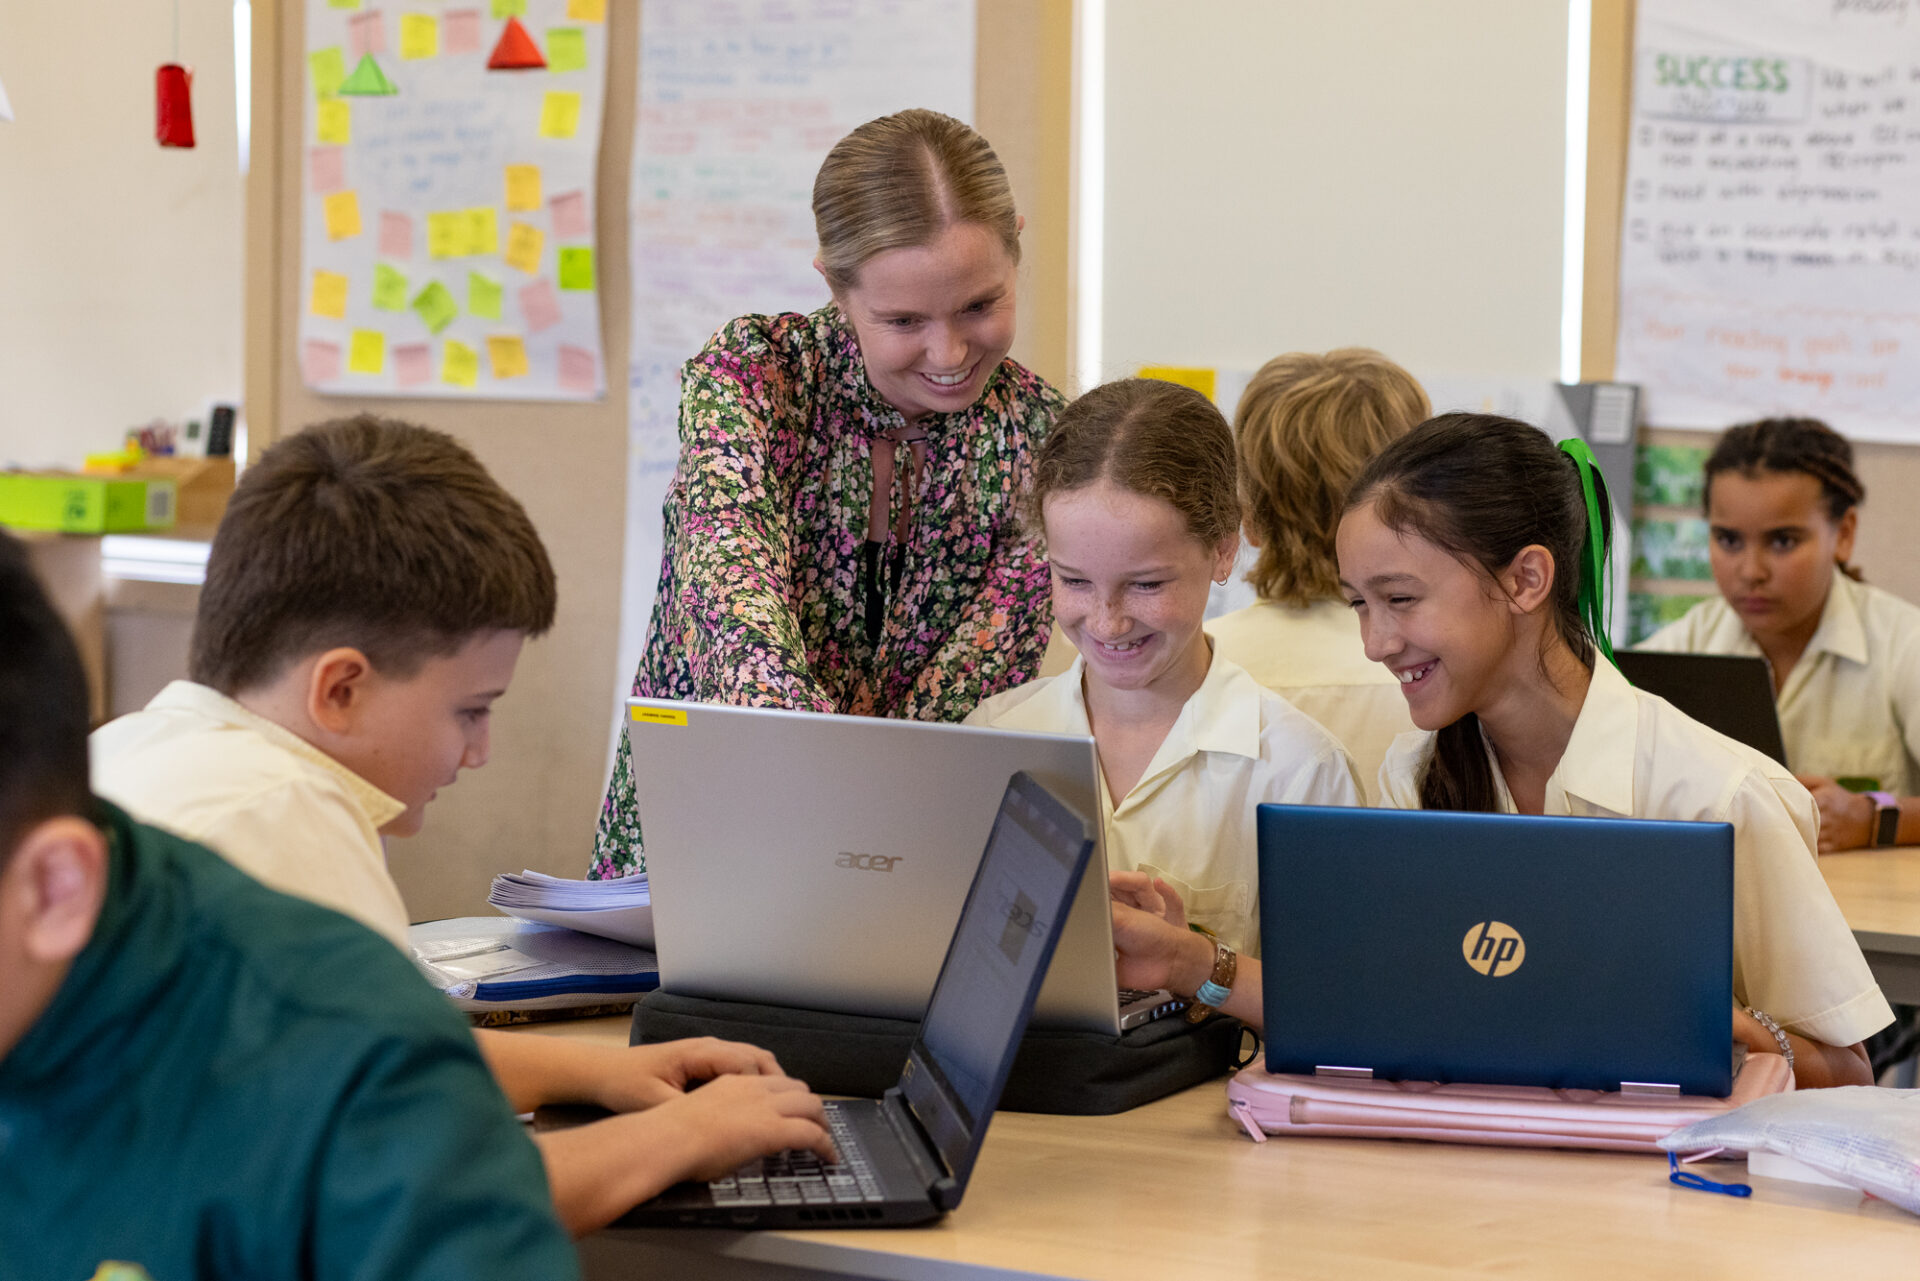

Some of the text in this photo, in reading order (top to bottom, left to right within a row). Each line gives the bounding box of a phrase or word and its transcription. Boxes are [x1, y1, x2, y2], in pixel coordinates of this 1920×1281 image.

[1655, 53, 1789, 94] SUCCESS
[835, 852, 903, 872] acer
[1470, 920, 1519, 977] hp
